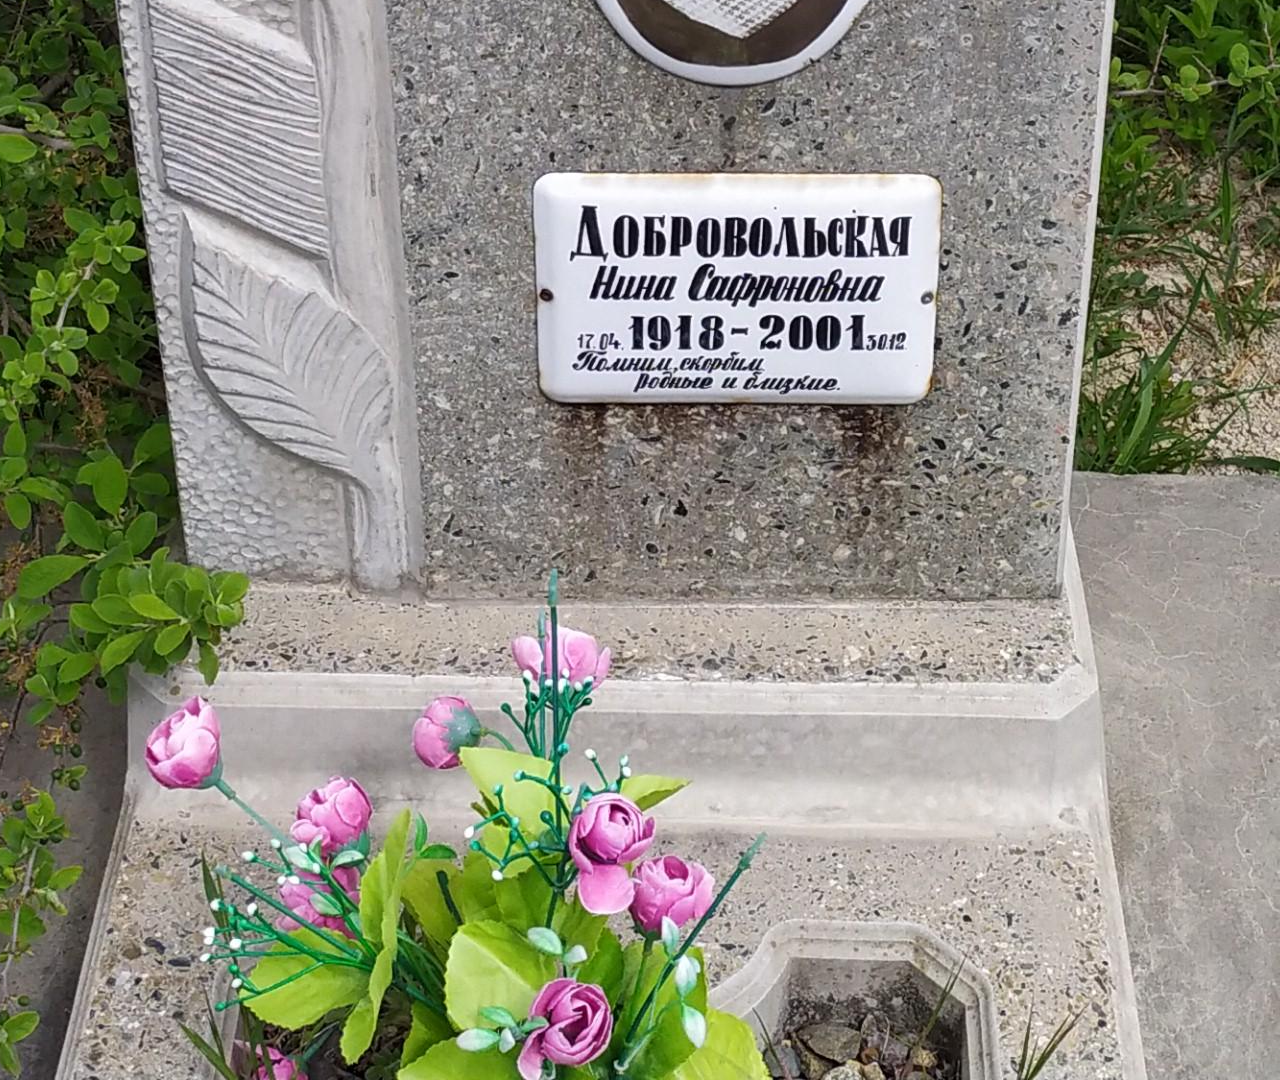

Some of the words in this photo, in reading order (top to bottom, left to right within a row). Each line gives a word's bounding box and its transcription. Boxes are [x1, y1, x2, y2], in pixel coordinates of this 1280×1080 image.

[570, 205, 912, 261] ДОБРОВОЛЬСКАЯ
[589, 265, 677, 300] Нина
[688, 263, 885, 308] Сафроновна
[633, 371, 713, 393] родные
[721, 377, 738, 389] и
